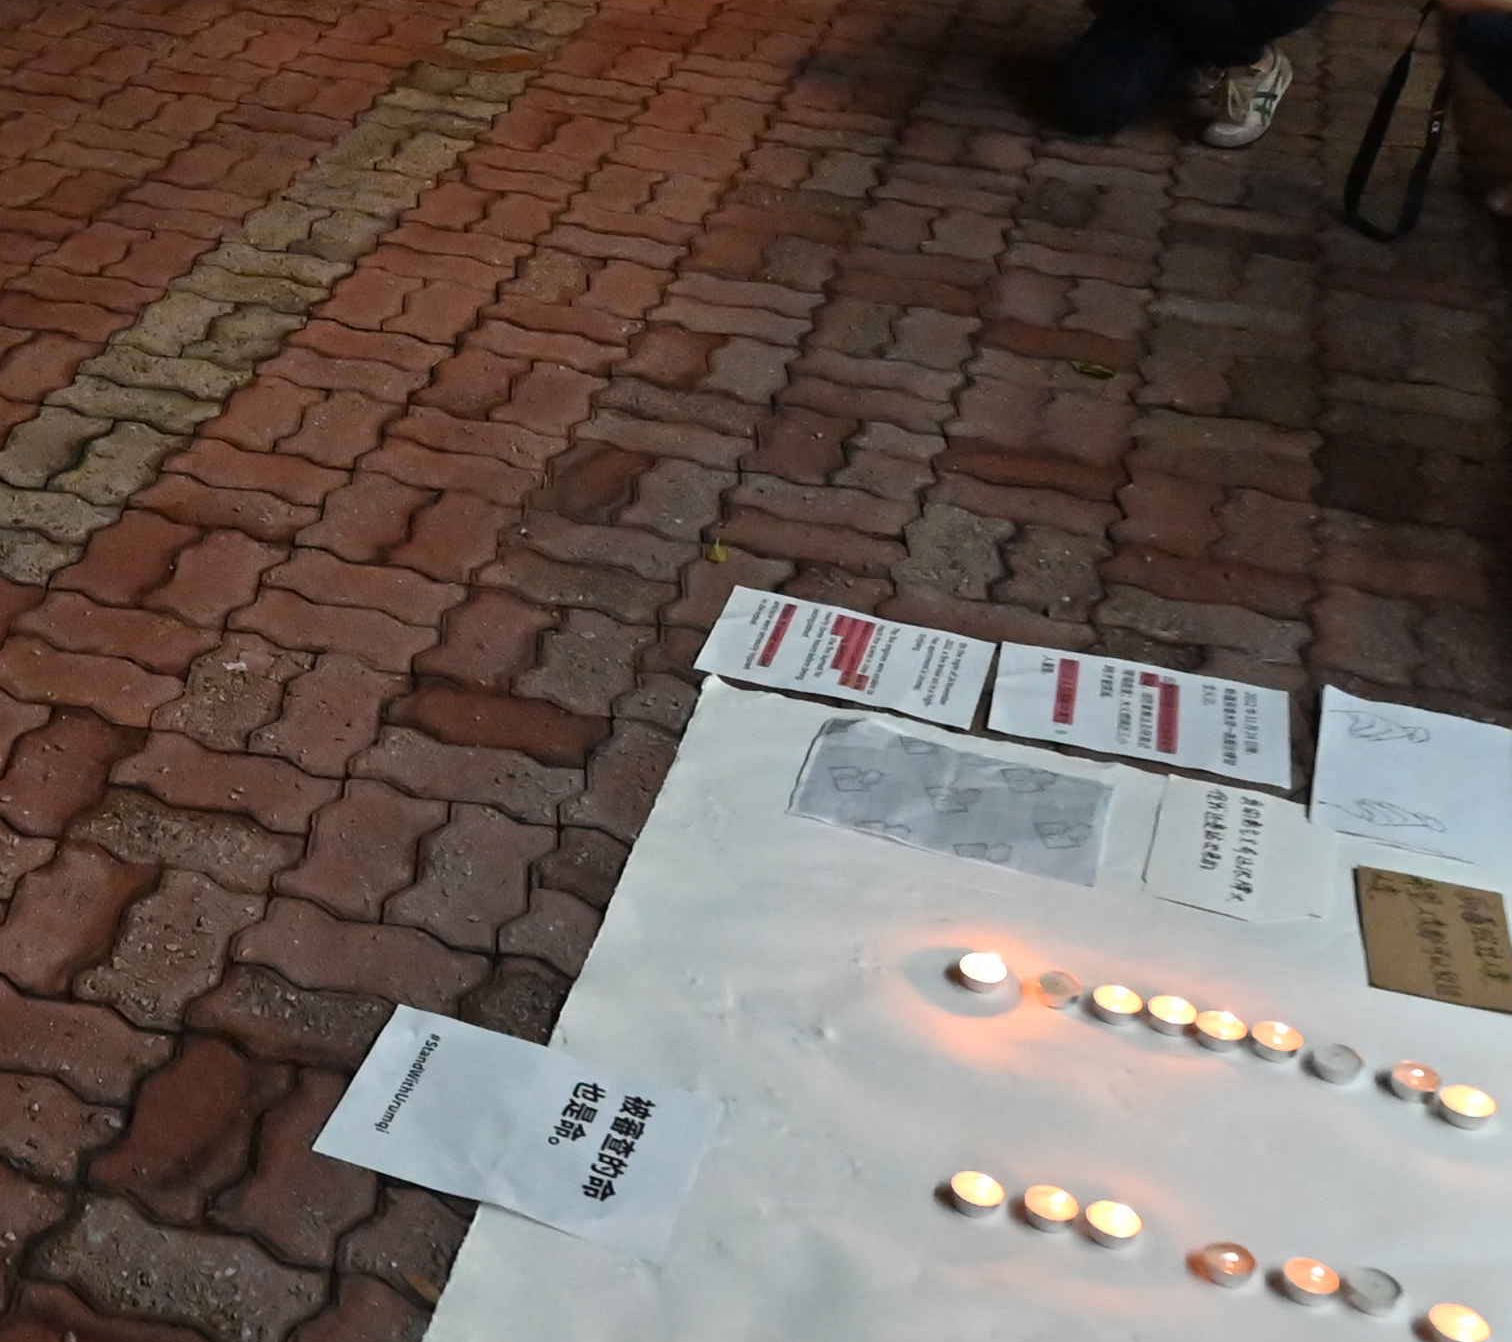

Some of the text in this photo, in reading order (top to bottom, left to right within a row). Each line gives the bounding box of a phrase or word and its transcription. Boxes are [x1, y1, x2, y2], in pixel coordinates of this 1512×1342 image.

[374, 1032, 442, 1135] #StandWithUrumqi
[548, 1081, 607, 1146] 也是命。
[582, 1093, 656, 1202] 被審查的命
